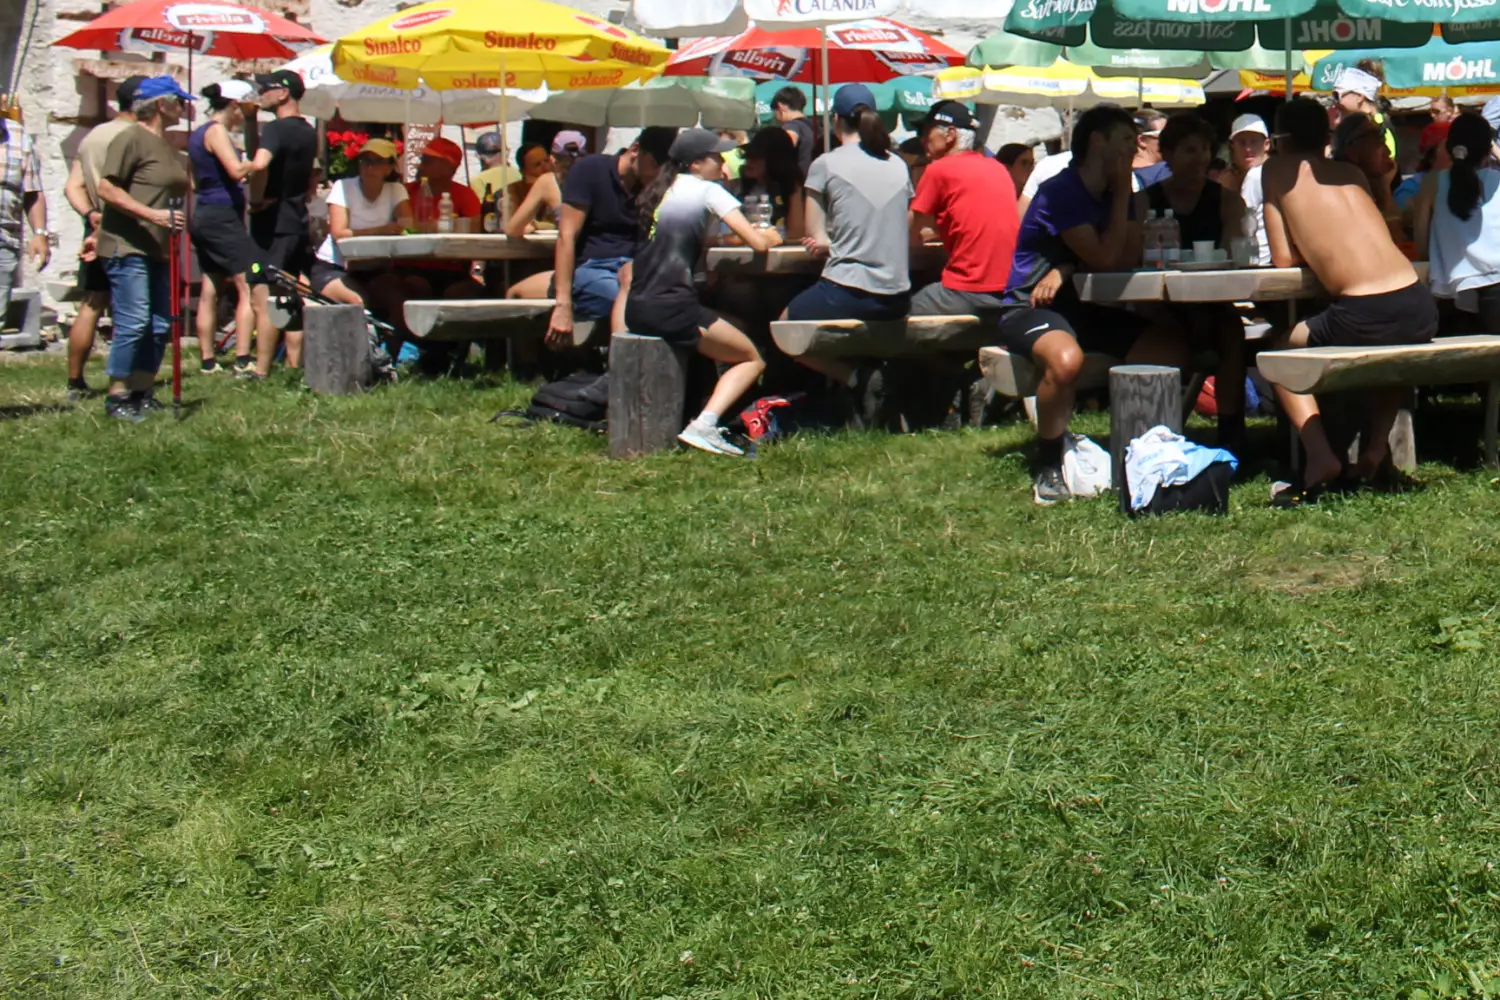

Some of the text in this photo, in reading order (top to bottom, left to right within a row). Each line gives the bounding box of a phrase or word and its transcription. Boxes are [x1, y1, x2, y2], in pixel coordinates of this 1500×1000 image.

[484, 31, 557, 50] Sinalco
[844, 29, 898, 42] rivella
[364, 35, 421, 56] Sinalco
